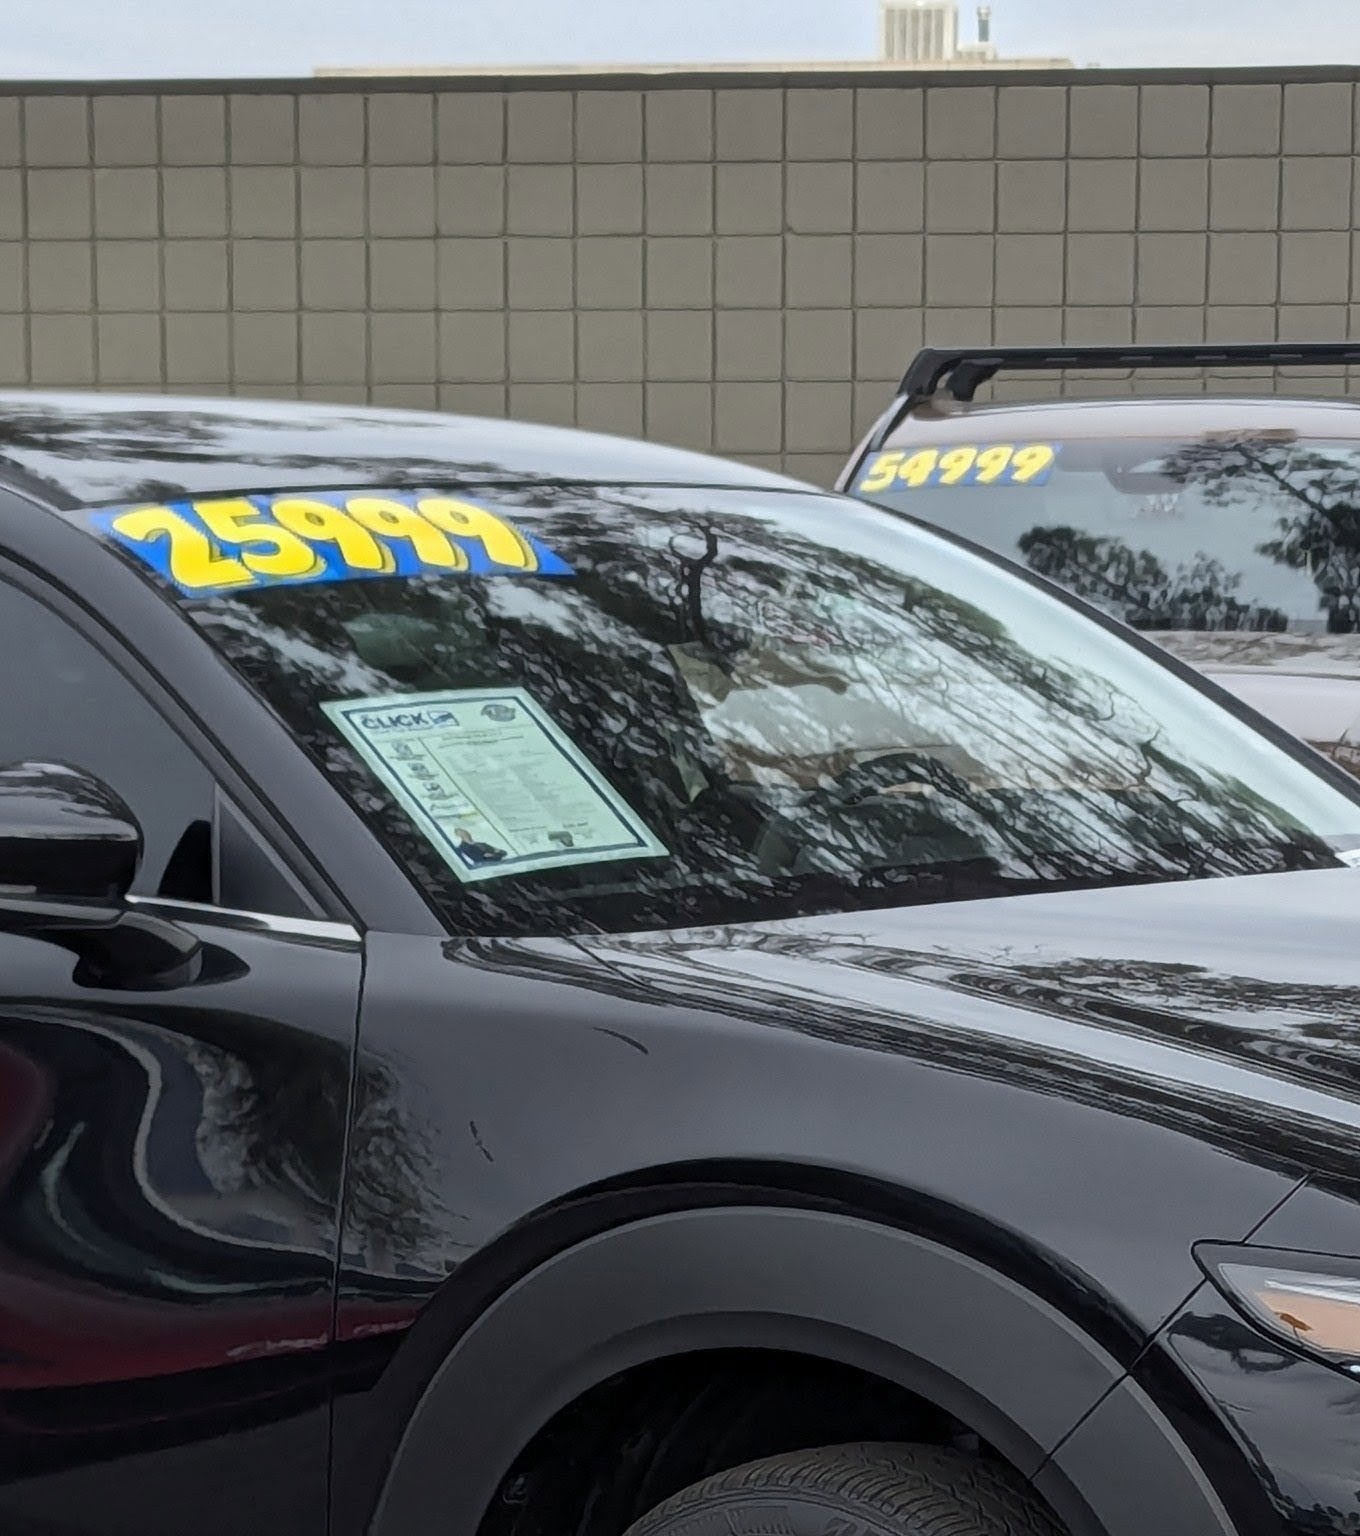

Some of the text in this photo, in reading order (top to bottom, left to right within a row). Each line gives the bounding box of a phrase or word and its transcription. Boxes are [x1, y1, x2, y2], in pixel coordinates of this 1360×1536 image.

[859, 444, 1055, 492] 54999
[112, 496, 538, 590] 25999
[360, 711, 429, 730] CLICK
